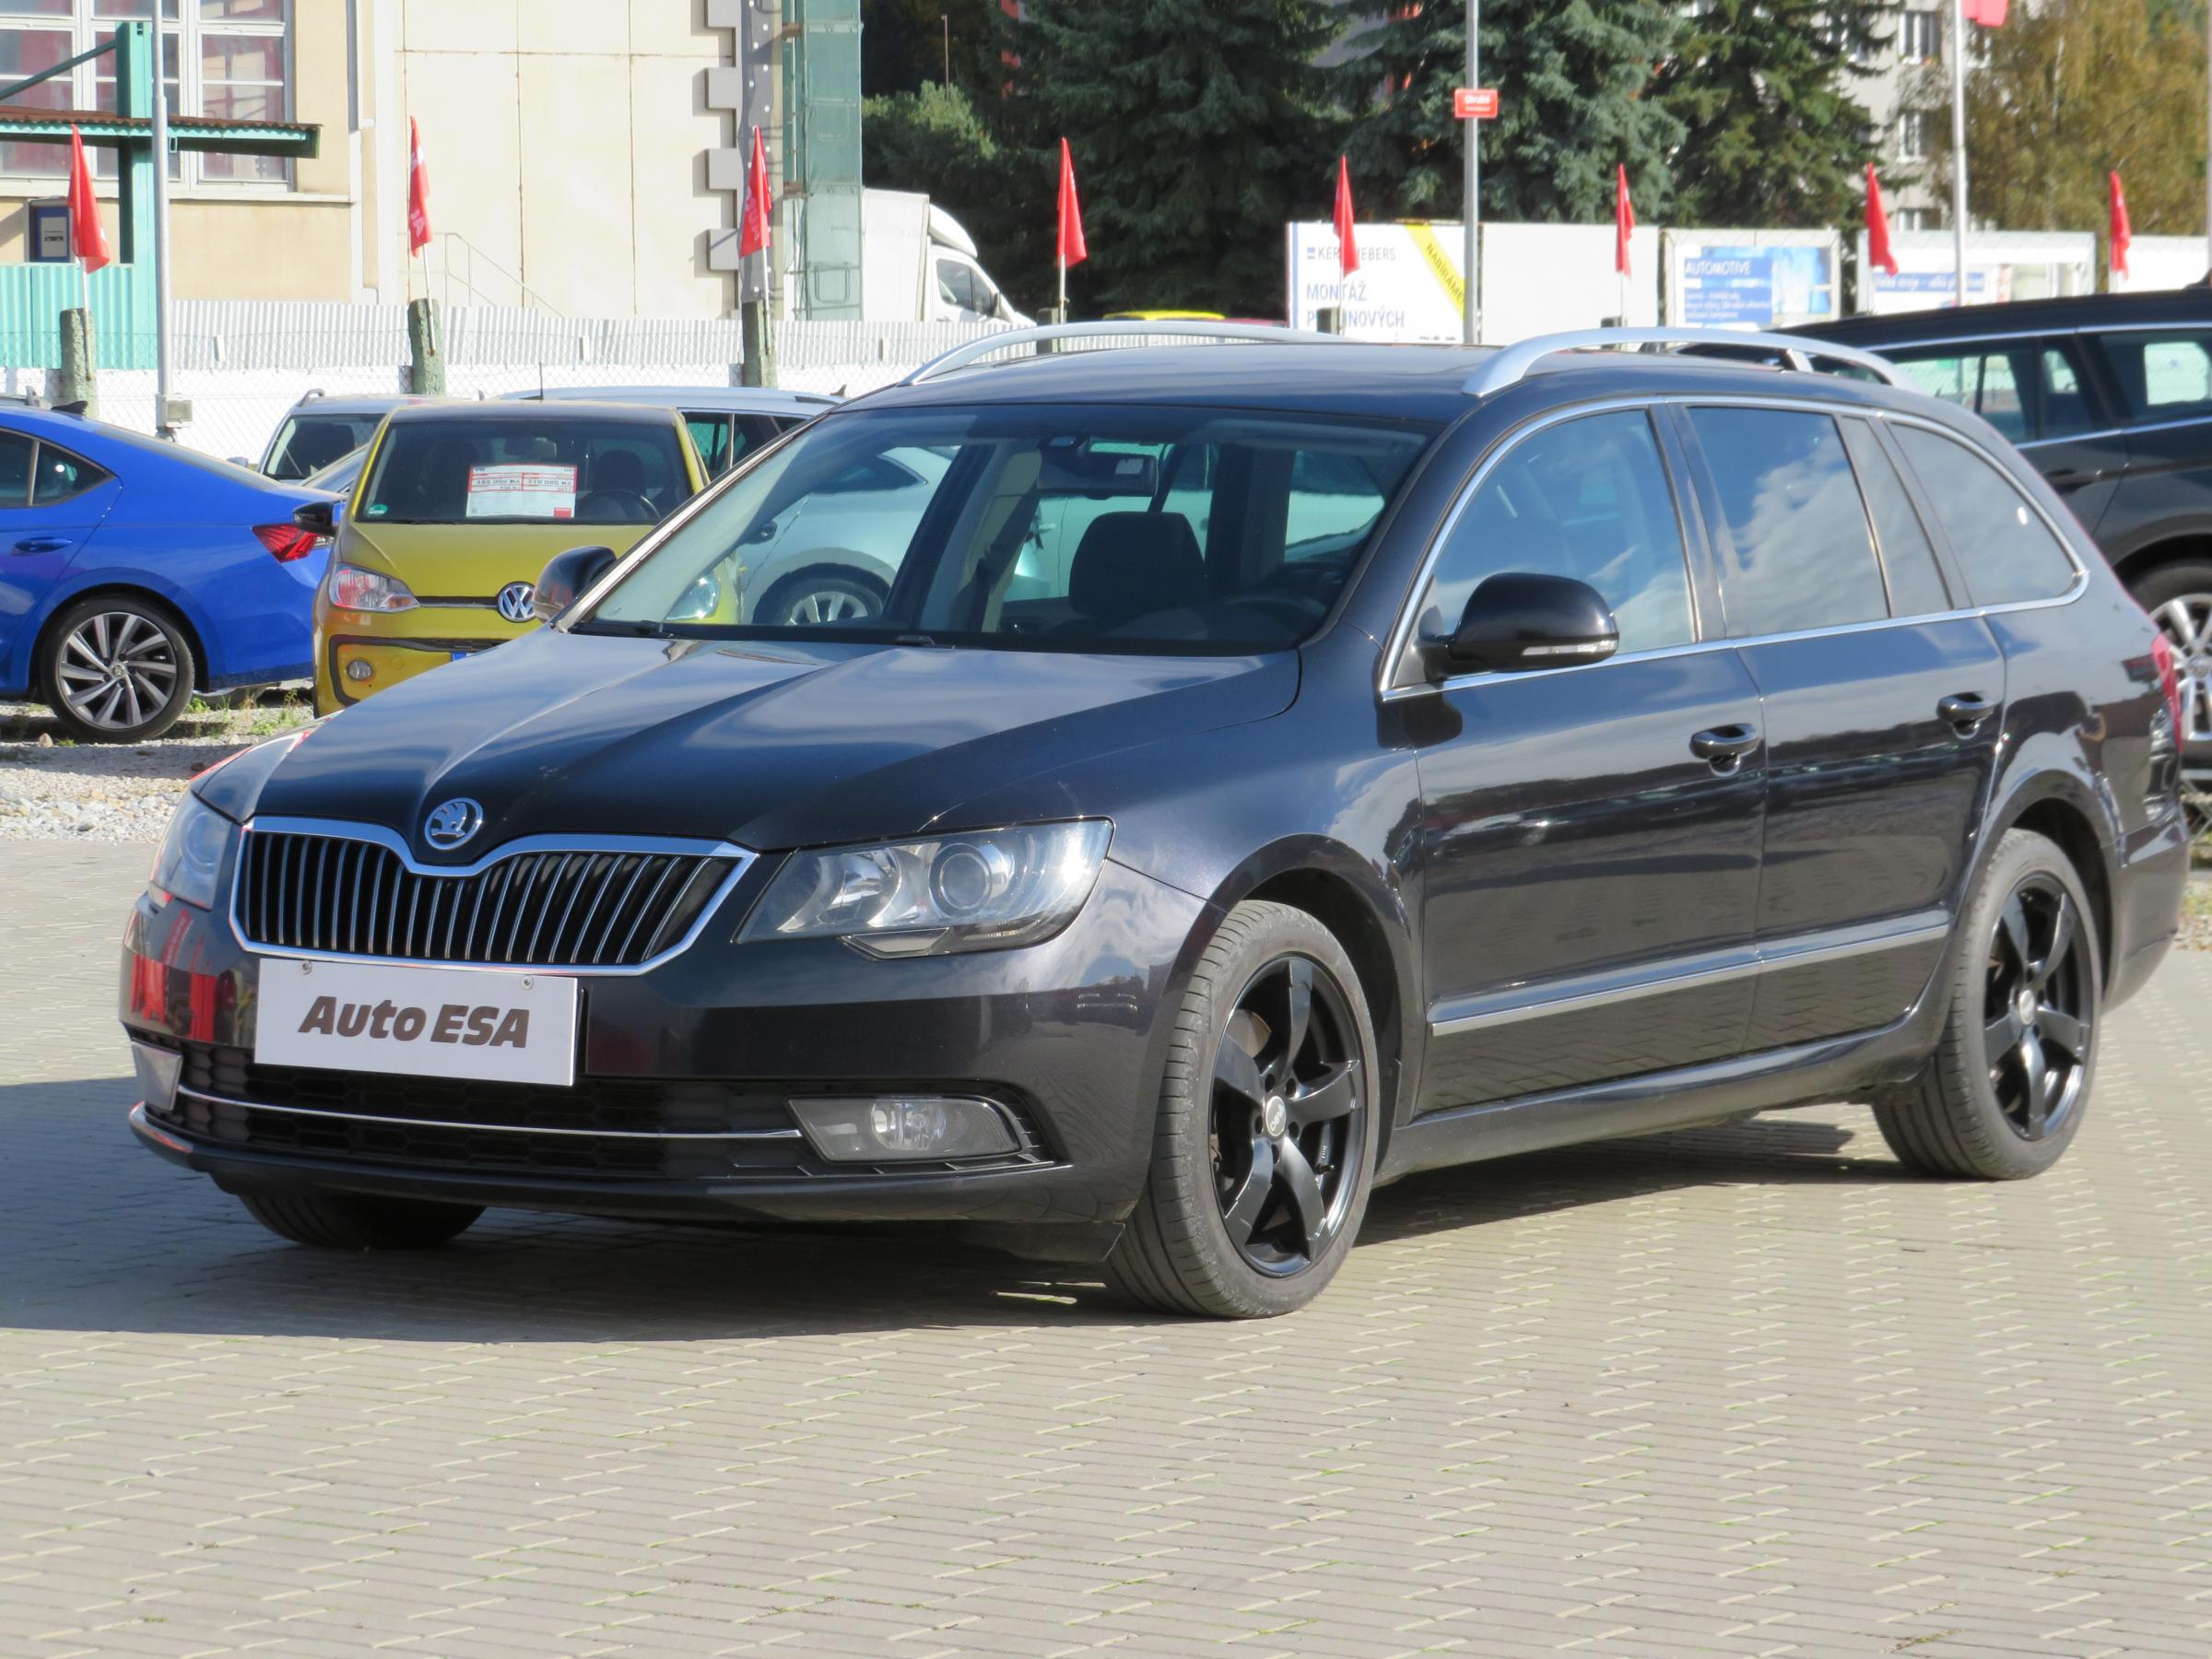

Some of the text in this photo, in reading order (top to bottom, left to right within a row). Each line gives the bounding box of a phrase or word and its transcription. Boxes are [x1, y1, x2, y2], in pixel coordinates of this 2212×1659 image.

[1685, 259, 1752, 276] AUTOMOTIVE
[1307, 279, 1367, 302] MONTÁŽ
[298, 995, 530, 1048] Auto ESA
